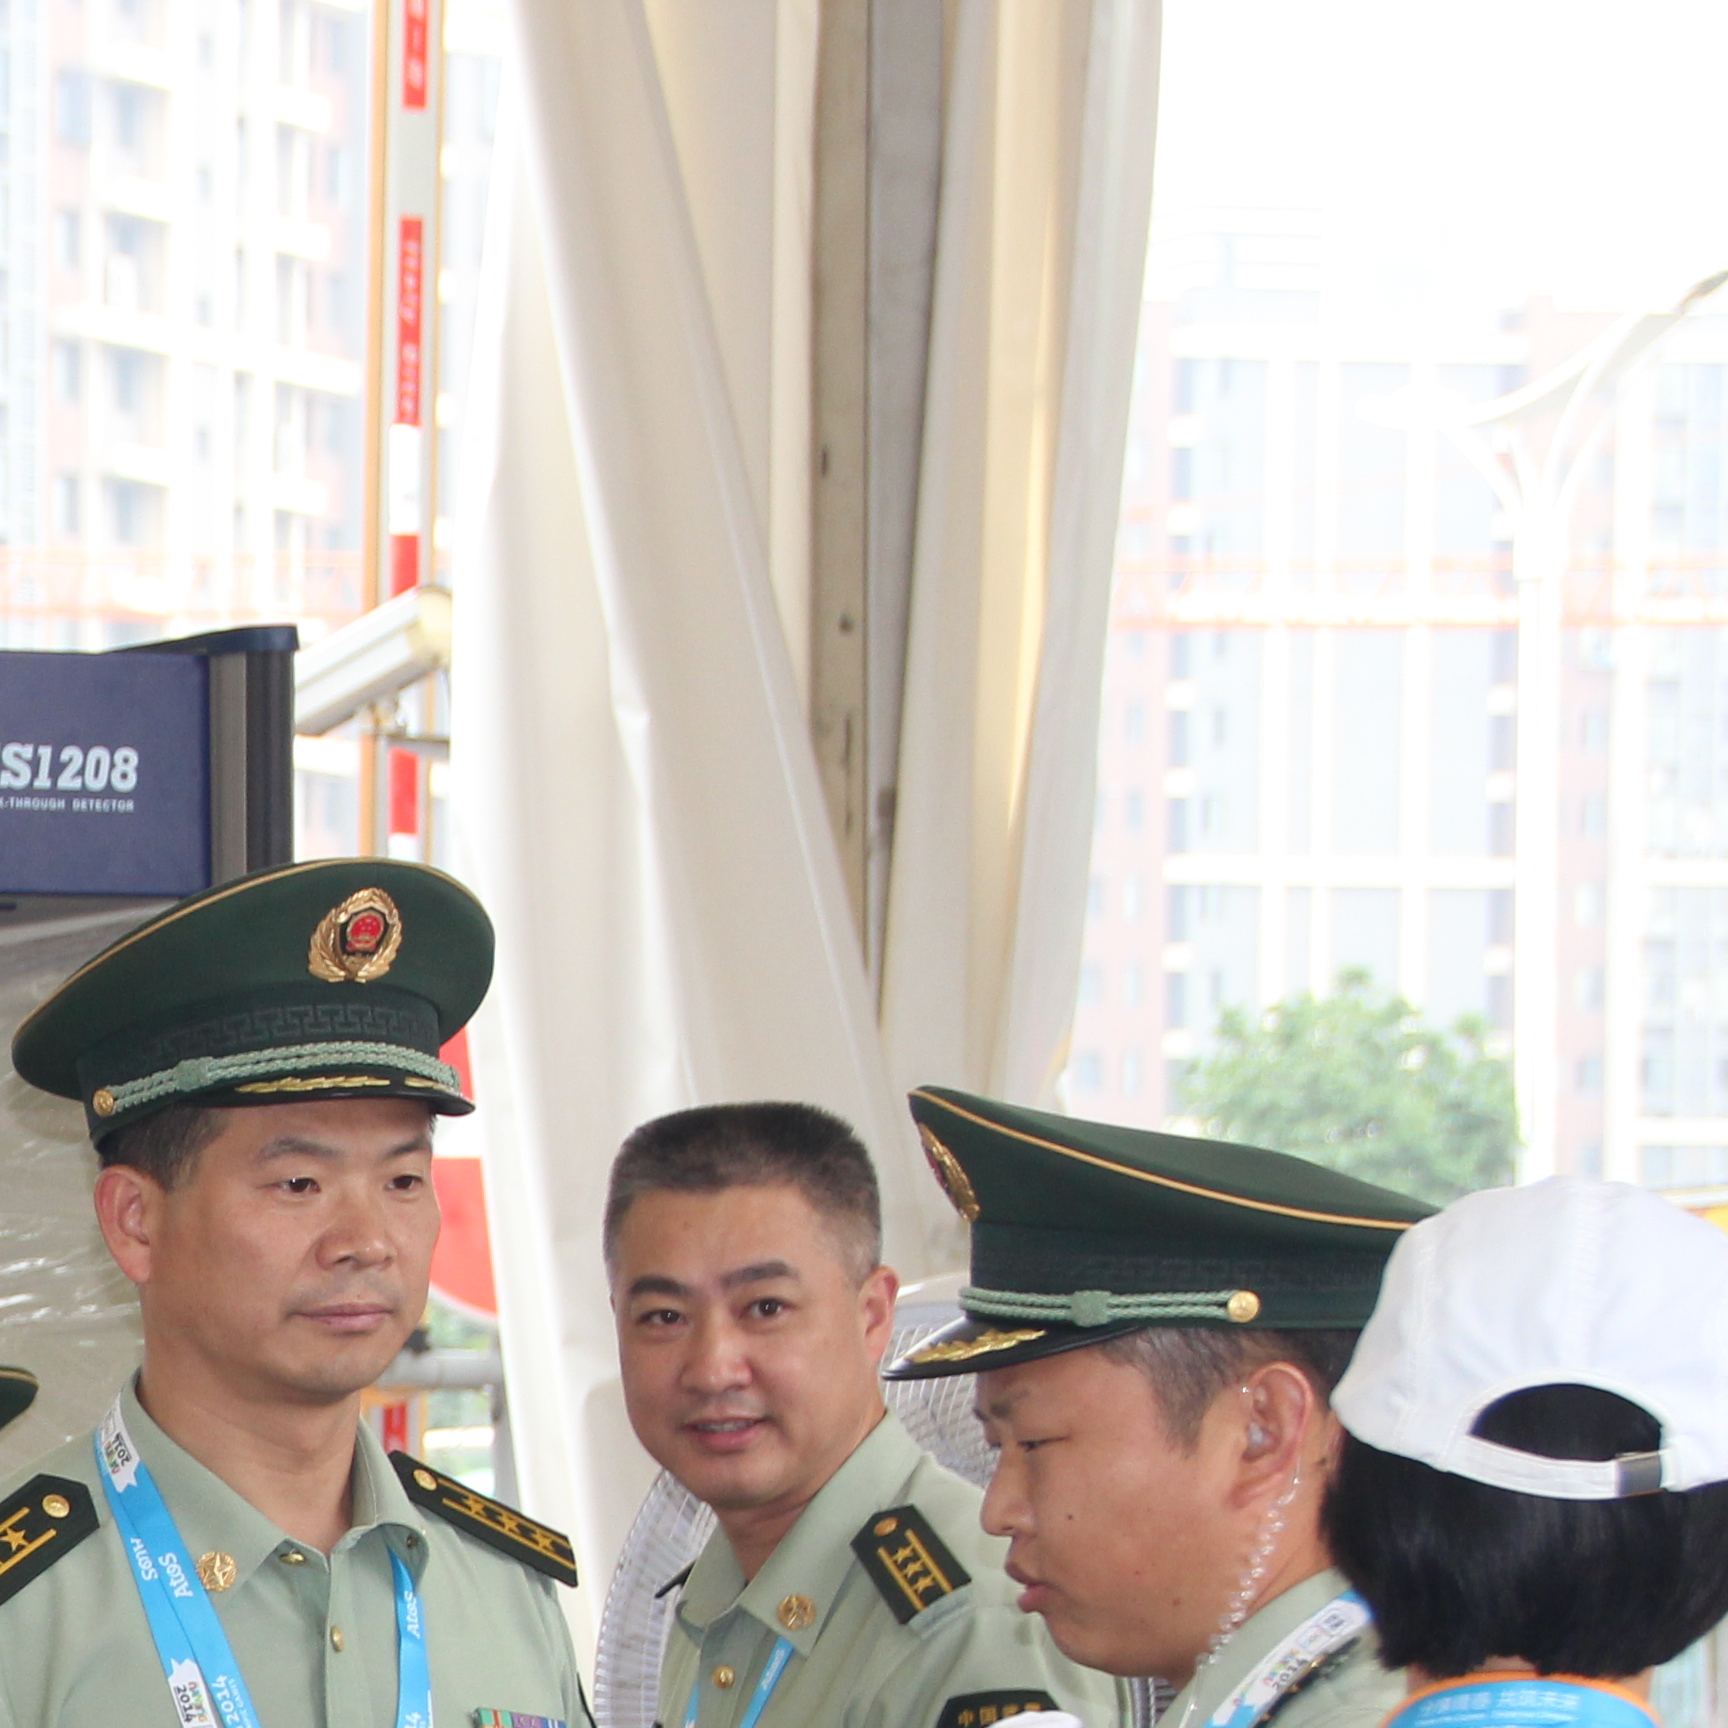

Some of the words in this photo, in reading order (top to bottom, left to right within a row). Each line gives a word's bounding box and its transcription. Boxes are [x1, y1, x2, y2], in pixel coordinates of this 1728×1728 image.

[72, 797, 135, 813] DETECTOR
[112, 1432, 133, 1467] 2014
[158, 1552, 193, 1598] Atos
[174, 1685, 194, 1723] 2014
[212, 1674, 239, 1725] 2014
